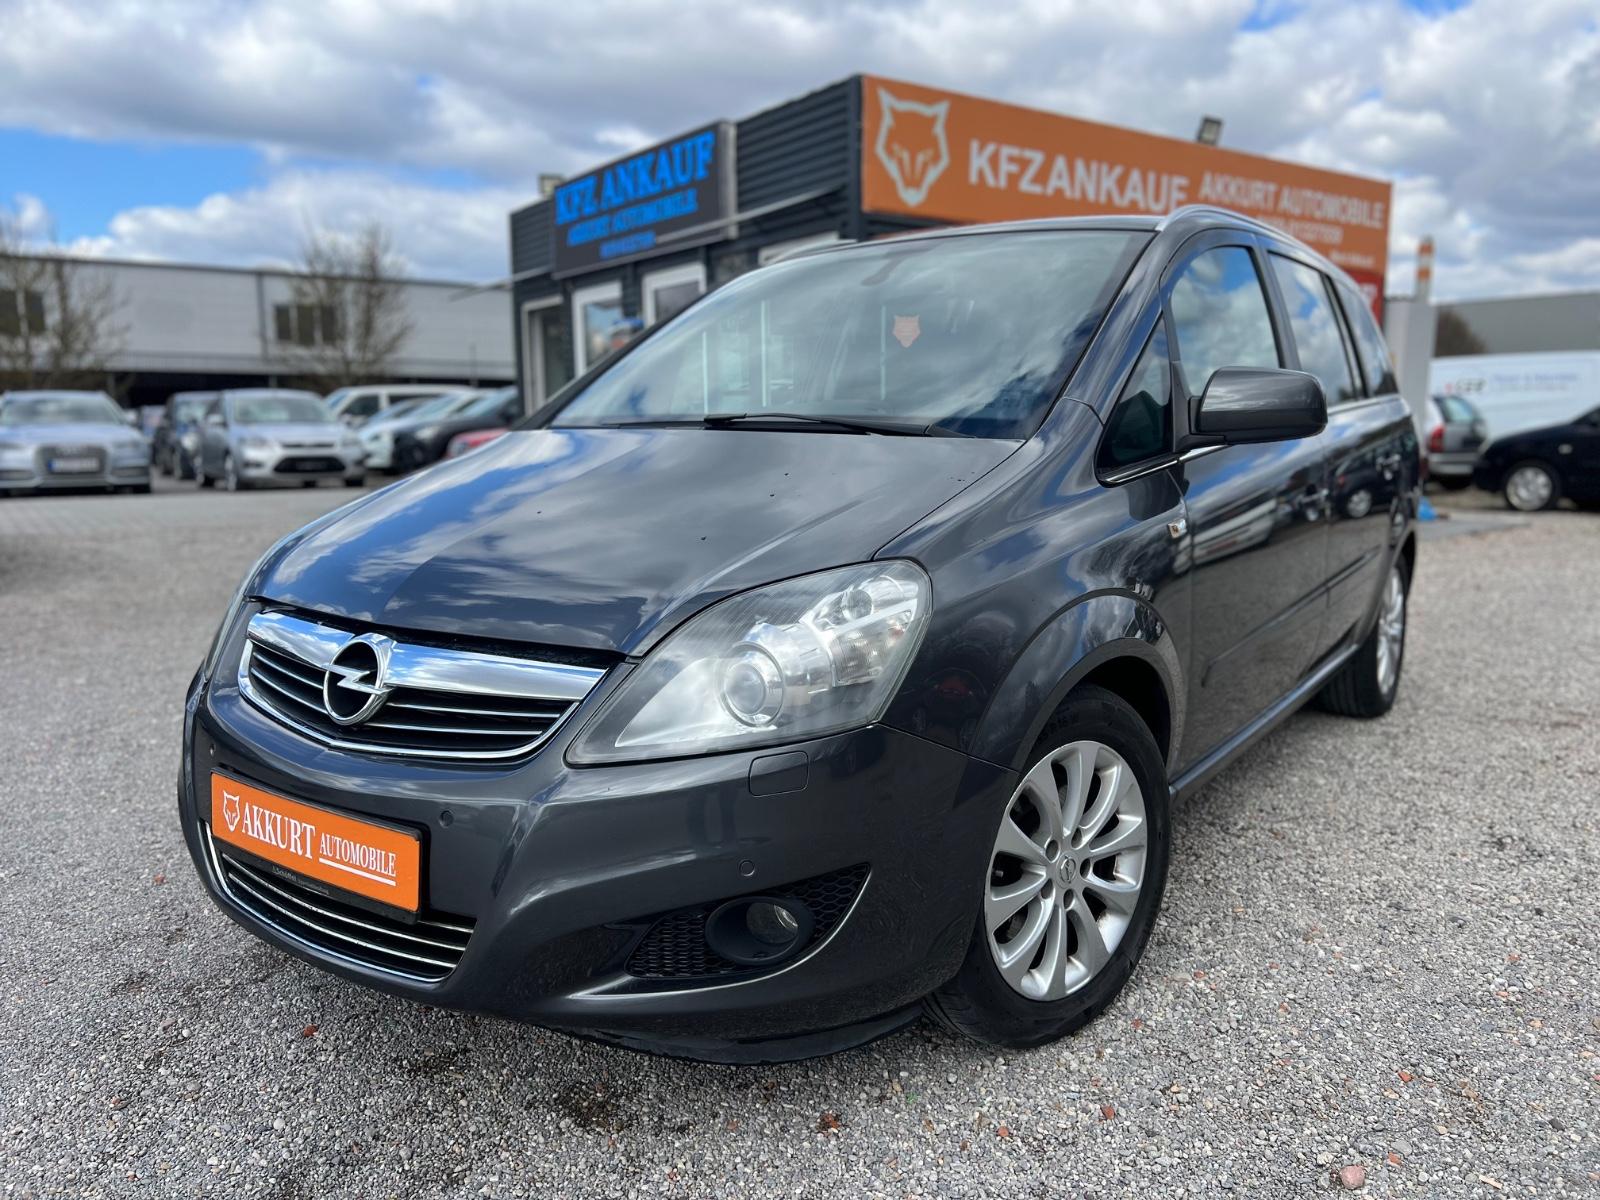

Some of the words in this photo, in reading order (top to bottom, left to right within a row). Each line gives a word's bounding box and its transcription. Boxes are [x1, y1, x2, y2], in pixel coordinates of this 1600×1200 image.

[555, 175, 597, 225] KFZ
[600, 131, 715, 210] ANKAUF
[1199, 171, 1278, 211] AKKURT
[1279, 186, 1386, 228] AUTOMOBILE
[241, 802, 316, 860] AKKURT
[319, 832, 396, 877] AUTOMOBILE
